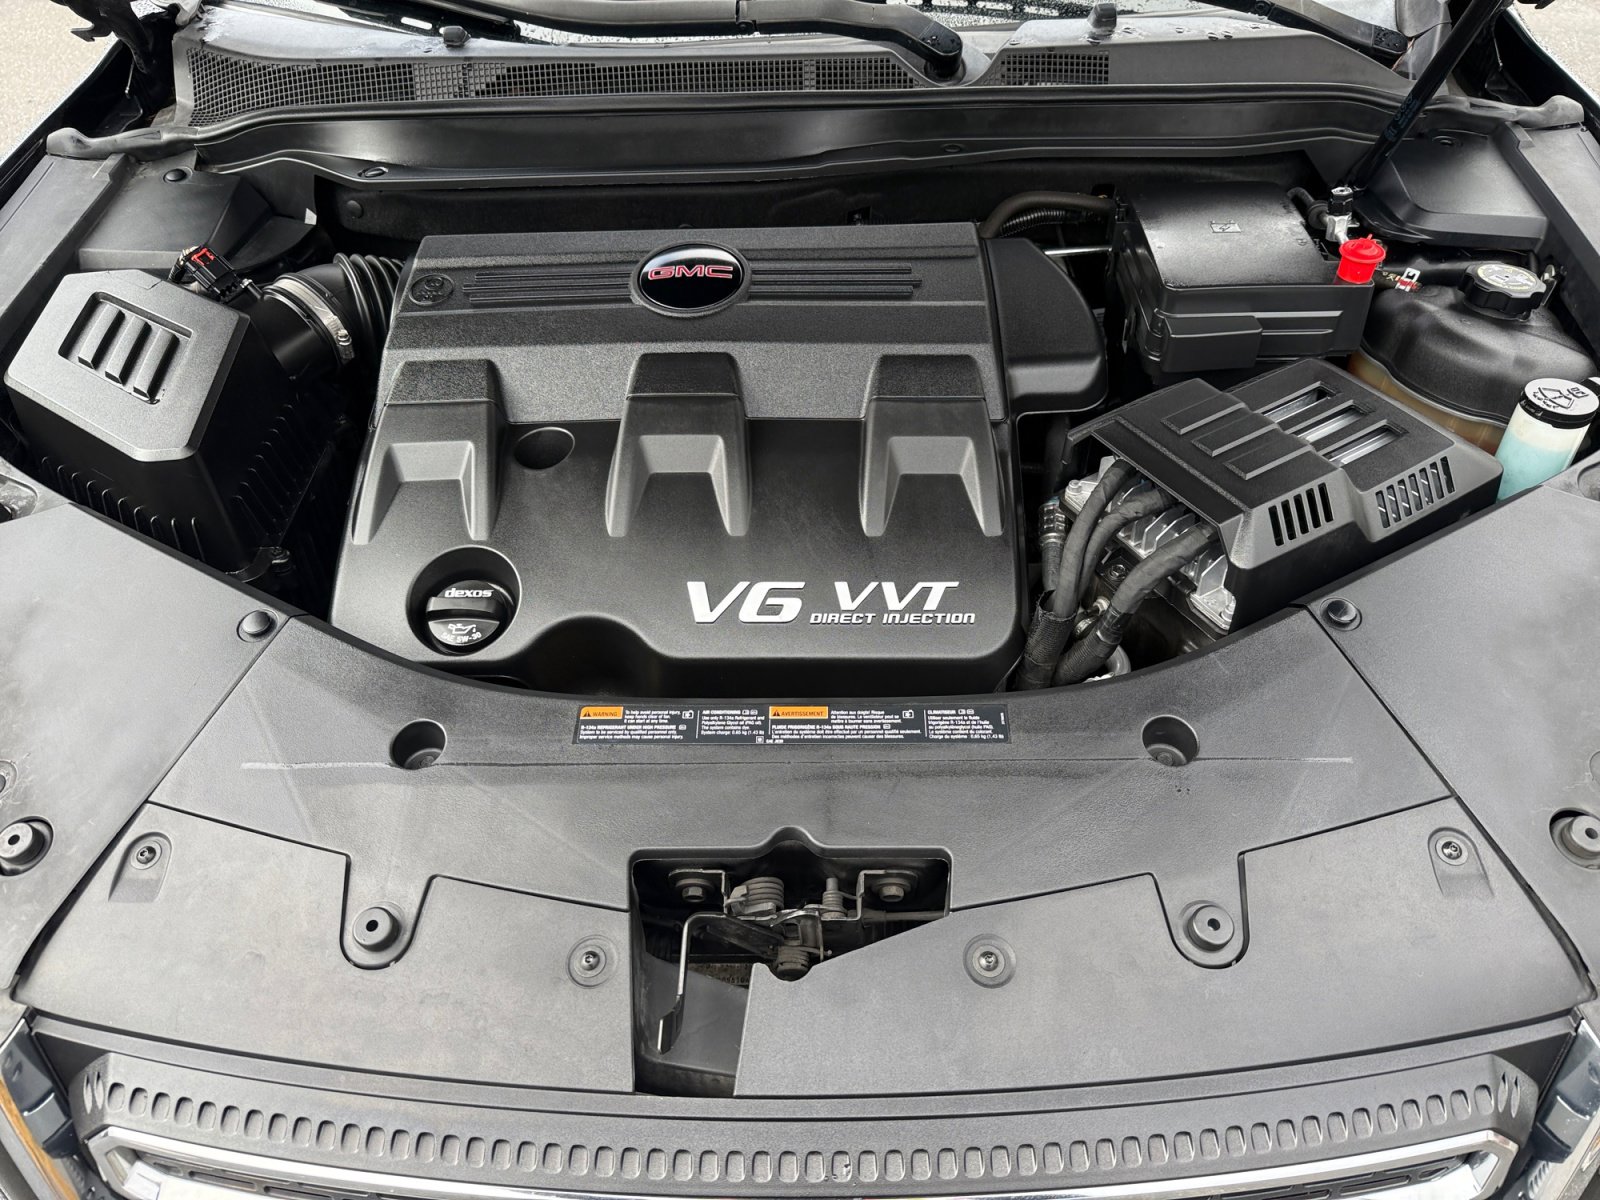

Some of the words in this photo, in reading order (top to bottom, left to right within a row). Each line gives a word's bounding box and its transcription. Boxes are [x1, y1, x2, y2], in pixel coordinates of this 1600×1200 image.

[648, 265, 733, 280] GMC
[445, 588, 494, 598] dexos
[687, 581, 805, 624] V6
[834, 581, 959, 611] VVT
[810, 613, 876, 624] DIRECT
[882, 613, 975, 624] INJECTION
[441, 632, 455, 642] SAE
[456, 632, 482, 643] 5W-30
